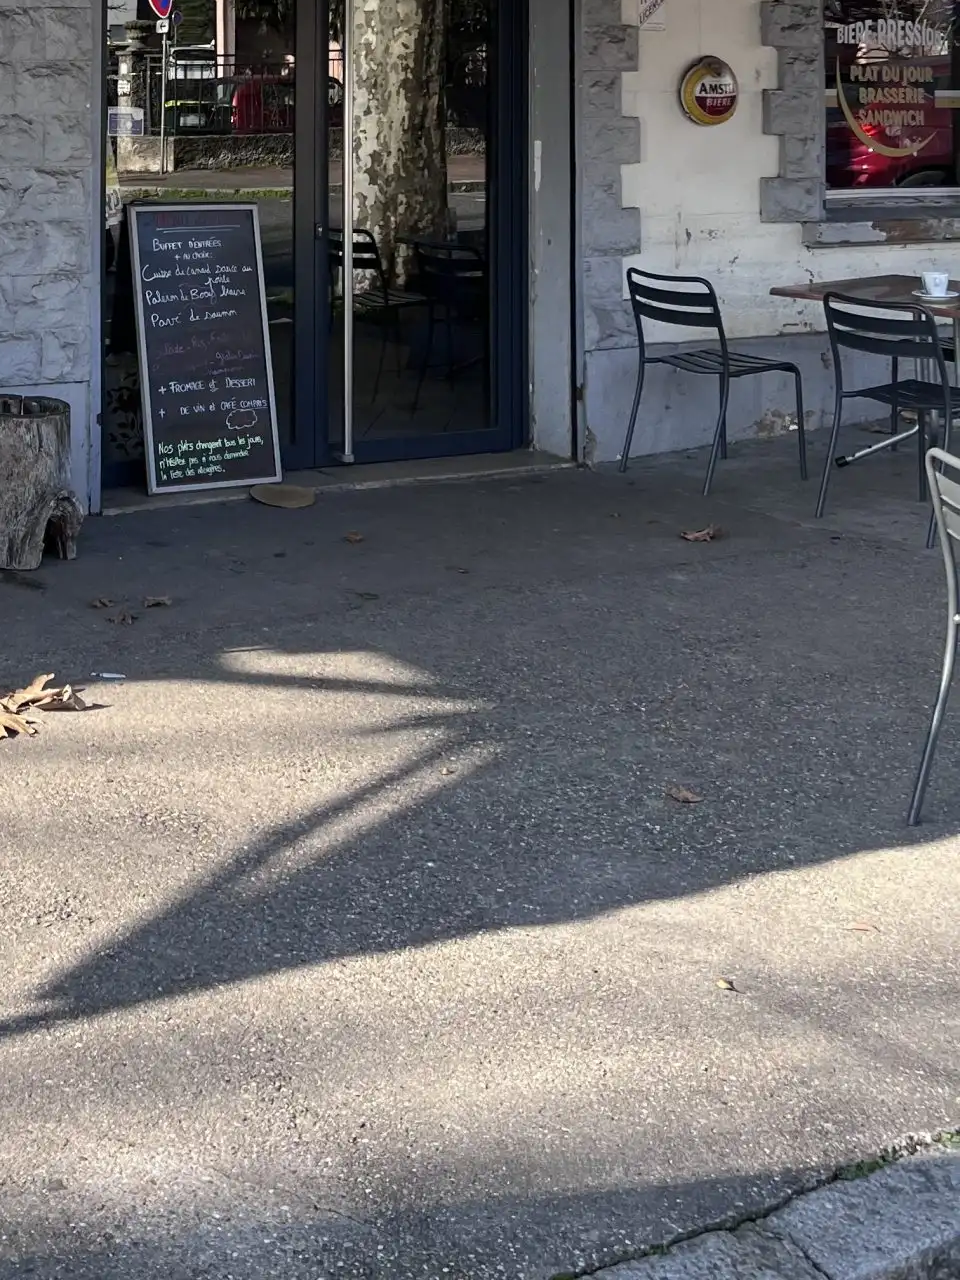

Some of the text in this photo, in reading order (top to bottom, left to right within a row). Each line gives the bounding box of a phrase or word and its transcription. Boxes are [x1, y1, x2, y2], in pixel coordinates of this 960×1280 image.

[850, 65, 934, 86] PLAT DU JOUR
[858, 87, 925, 104] BRASSERIE
[857, 109, 925, 127] SANDWICH
[189, 308, 200, 322] de
[158, 441, 174, 455] Nos
